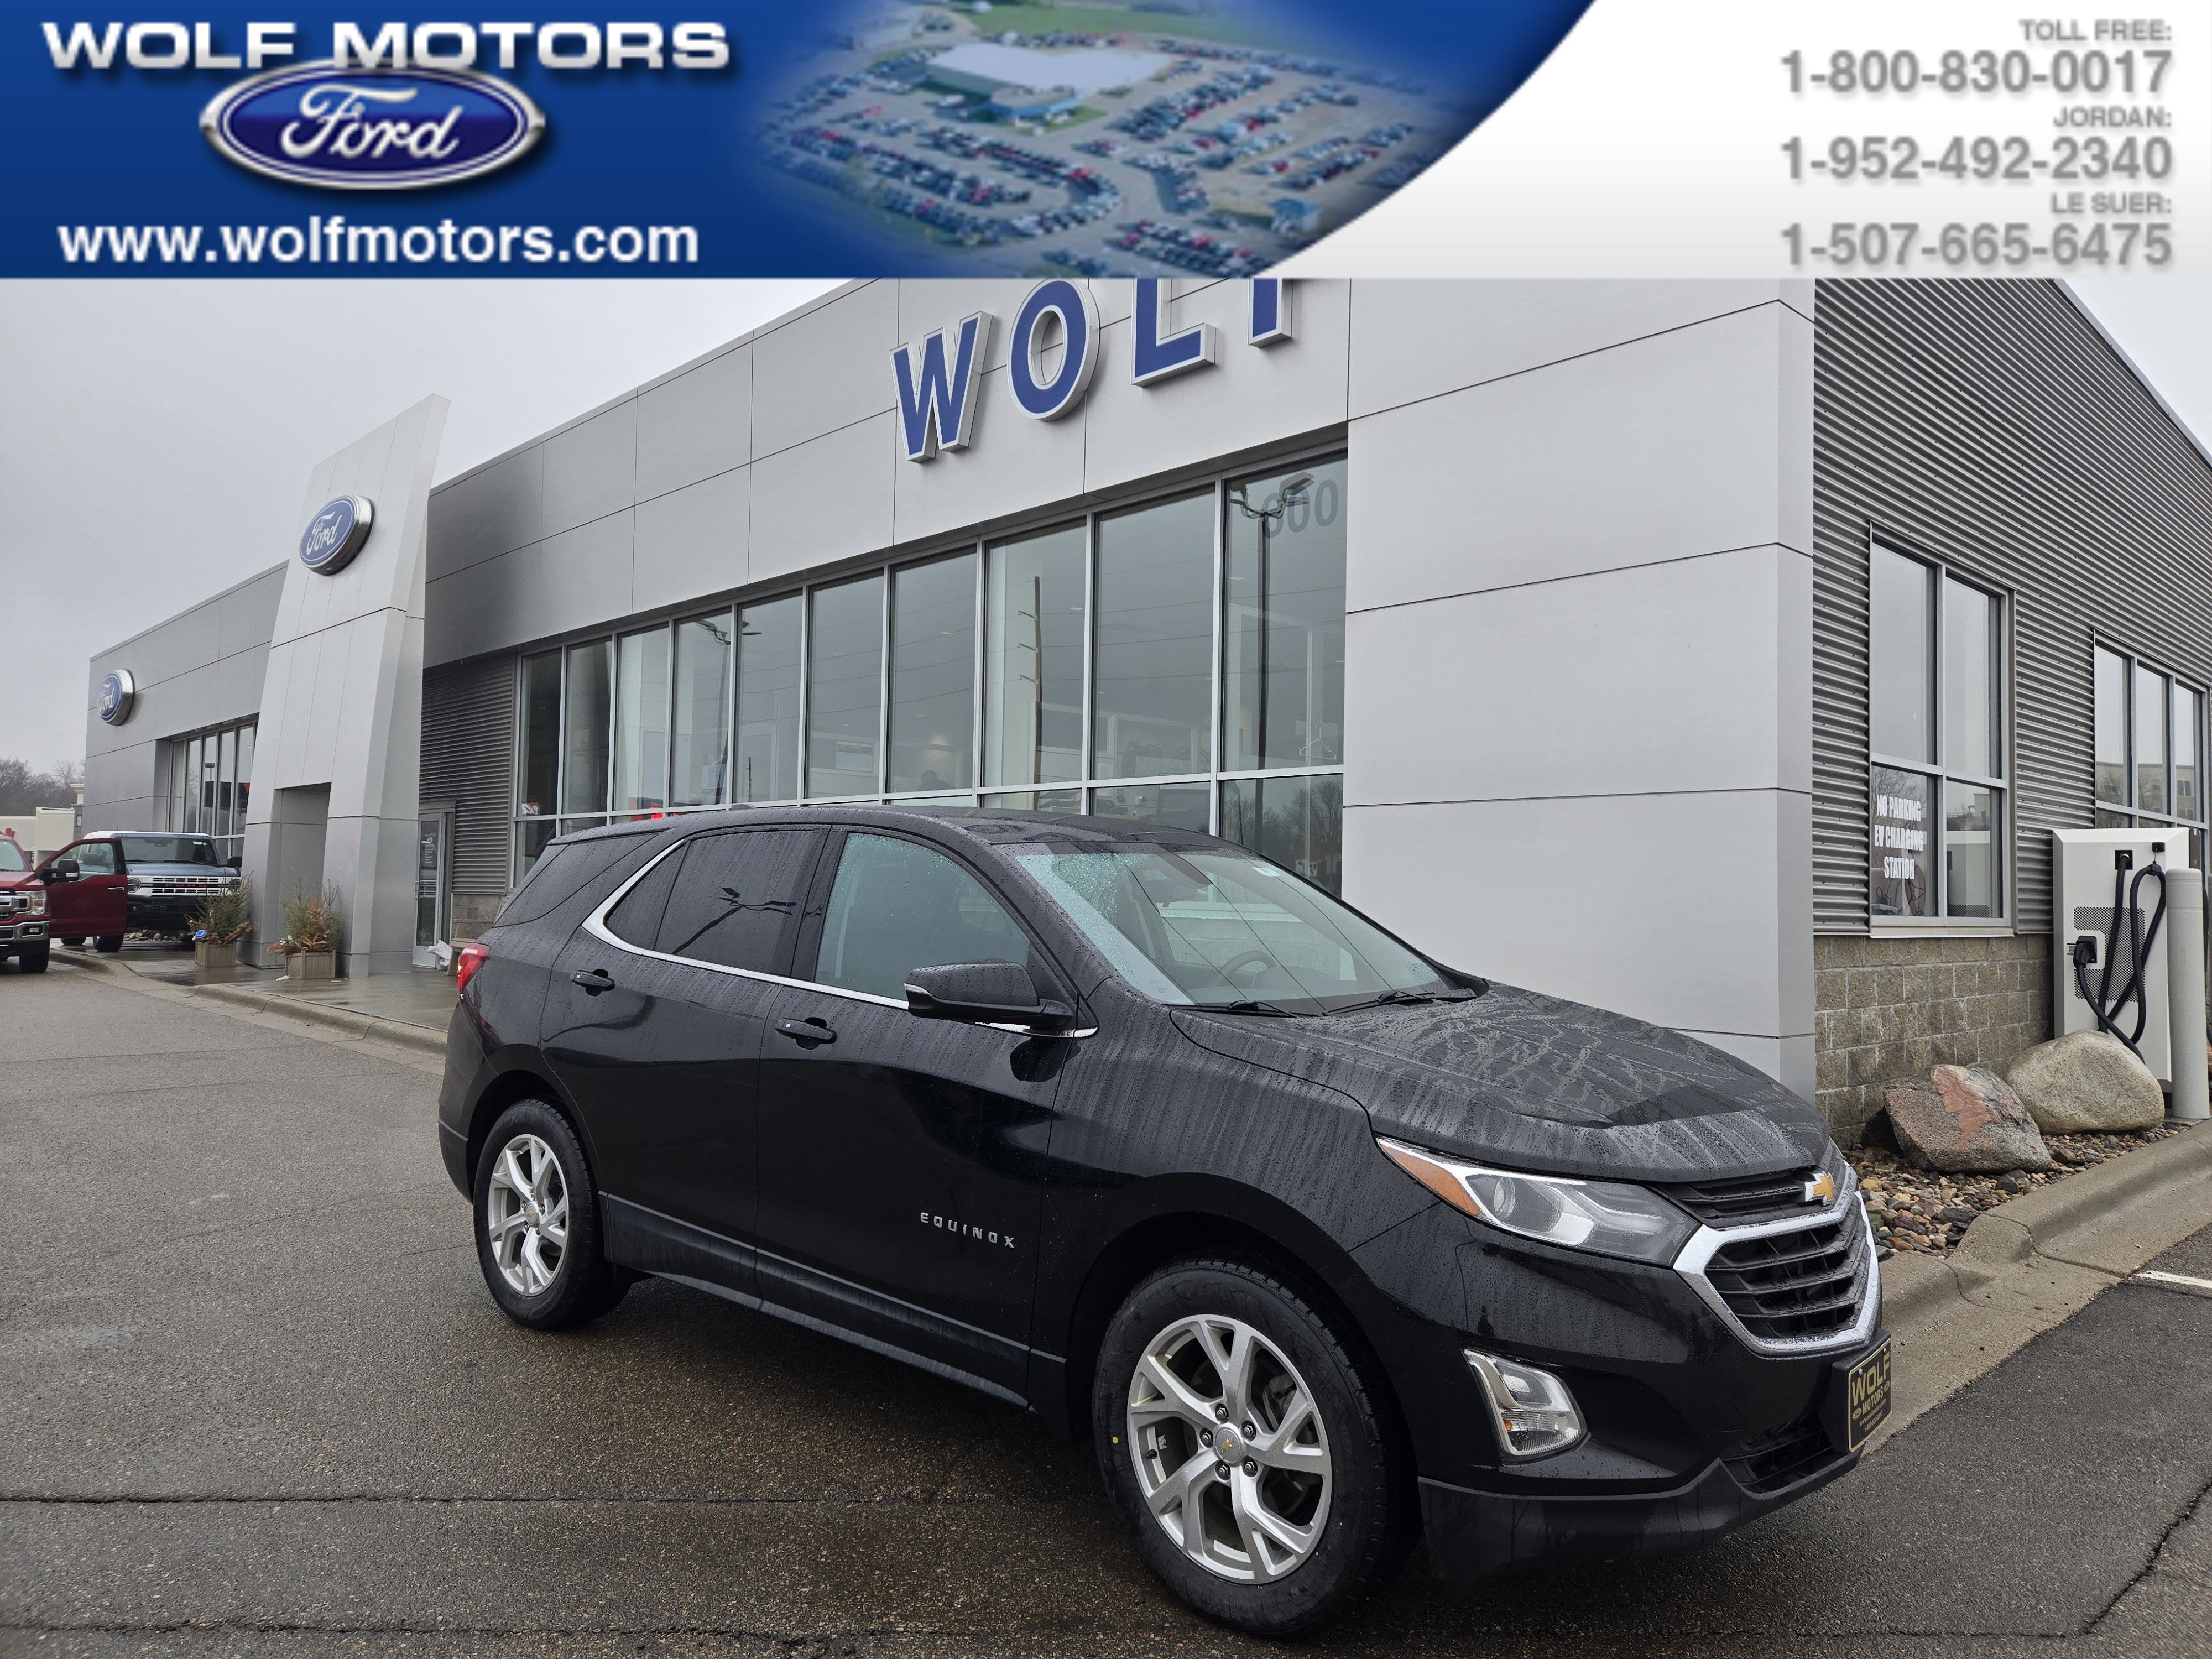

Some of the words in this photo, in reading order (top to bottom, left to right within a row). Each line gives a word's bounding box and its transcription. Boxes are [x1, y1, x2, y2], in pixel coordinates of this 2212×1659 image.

[306, 510, 342, 556] Ford
[98, 682, 115, 712] Ford
[1876, 794, 1887, 817] NO
[1889, 796, 1921, 822] PARKING
[1874, 825, 1884, 847] EV
[1885, 826, 1923, 851] CHARGING
[1884, 855, 1915, 880] STATION
[920, 1212, 1014, 1249] EQUINOX
[1852, 1352, 1890, 1406] WOLF
[1863, 1386, 1884, 1415] MOTORS
